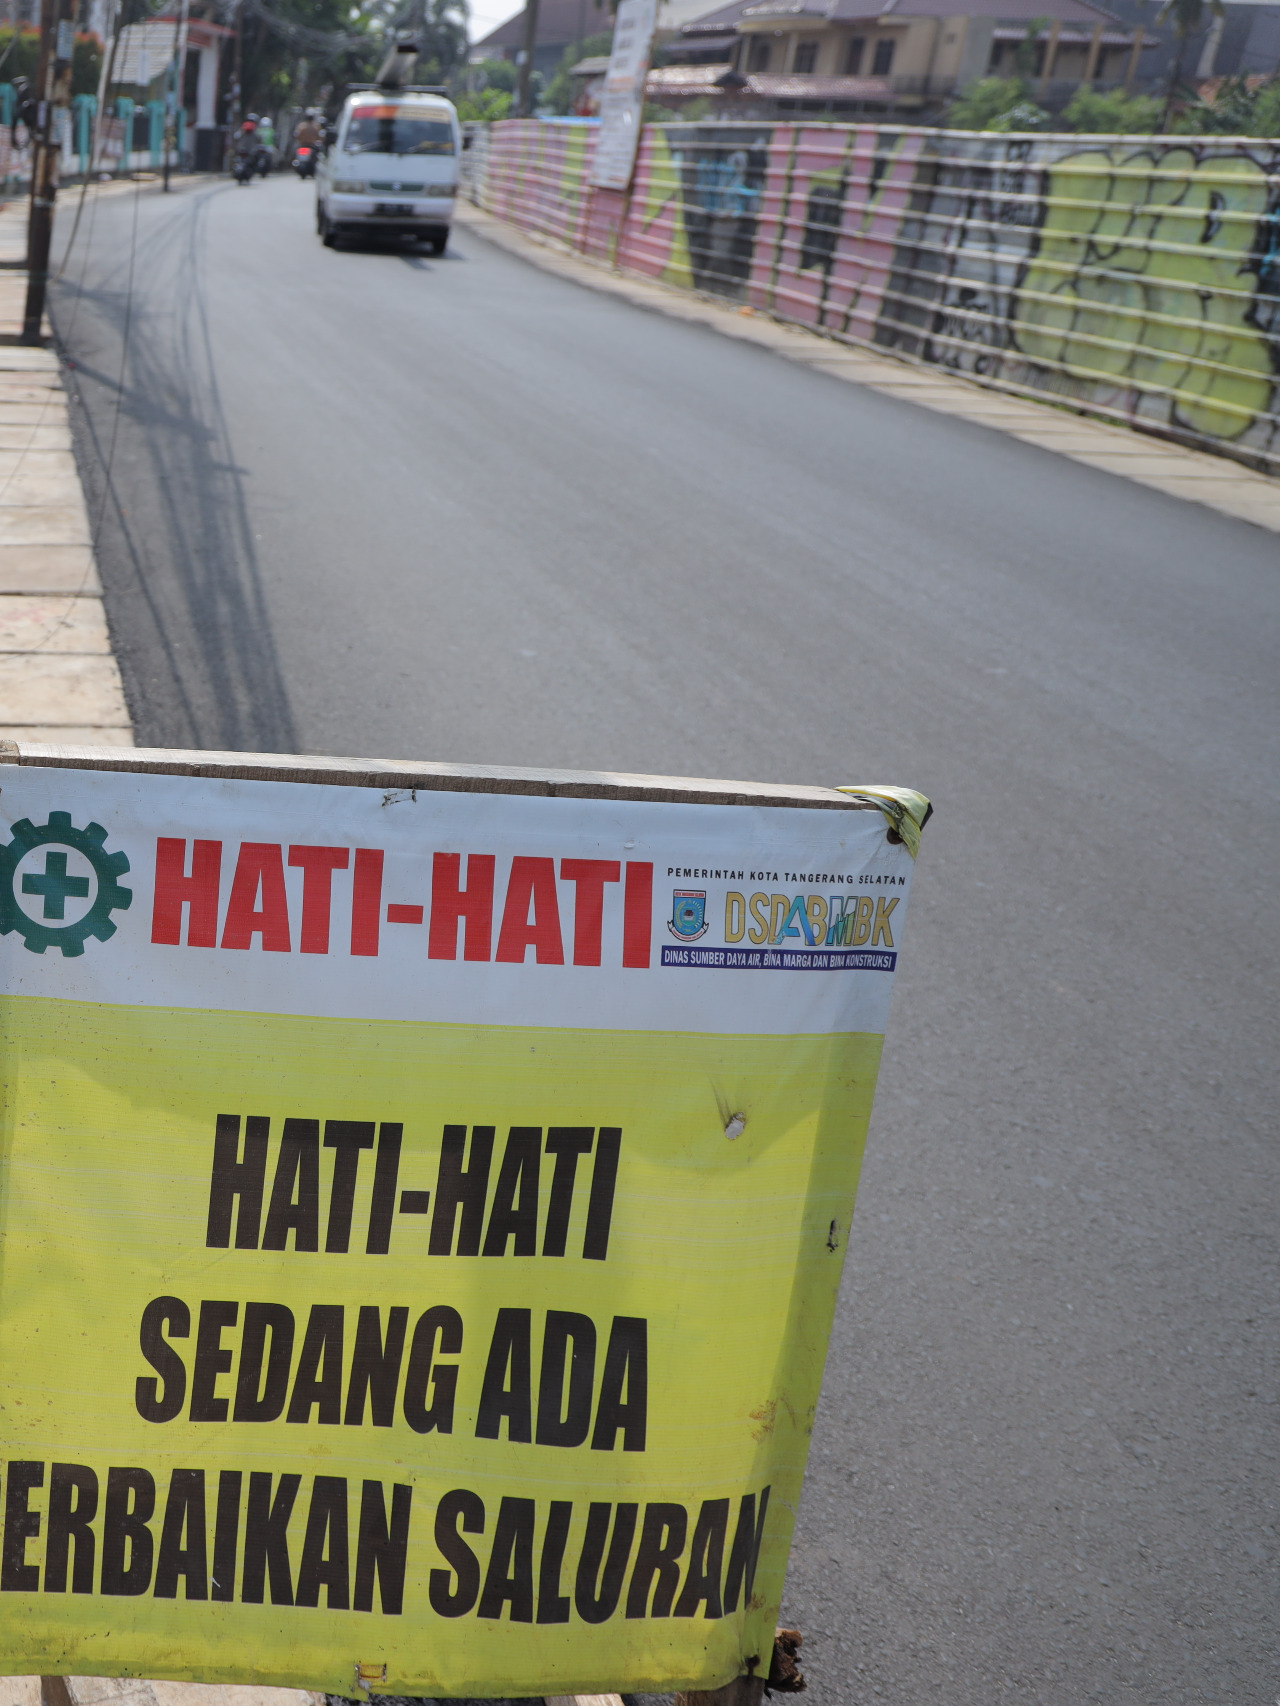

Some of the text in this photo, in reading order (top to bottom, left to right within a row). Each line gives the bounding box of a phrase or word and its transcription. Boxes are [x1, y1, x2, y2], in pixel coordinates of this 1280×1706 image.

[151, 837, 654, 969] HATI-HATI
[667, 867, 906, 886] PEMERINTAH KOTA TANGERANG SELATAN
[664, 949, 892, 969] DINAS SUMBER DAYA AIR, BINA MARGA DAN BINA KONSTRUKSI
[205, 1113, 623, 1261] HATI-HATI
[135, 1295, 648, 1452] SEDANG ADA
[428, 1484, 772, 1625] SALURAN
